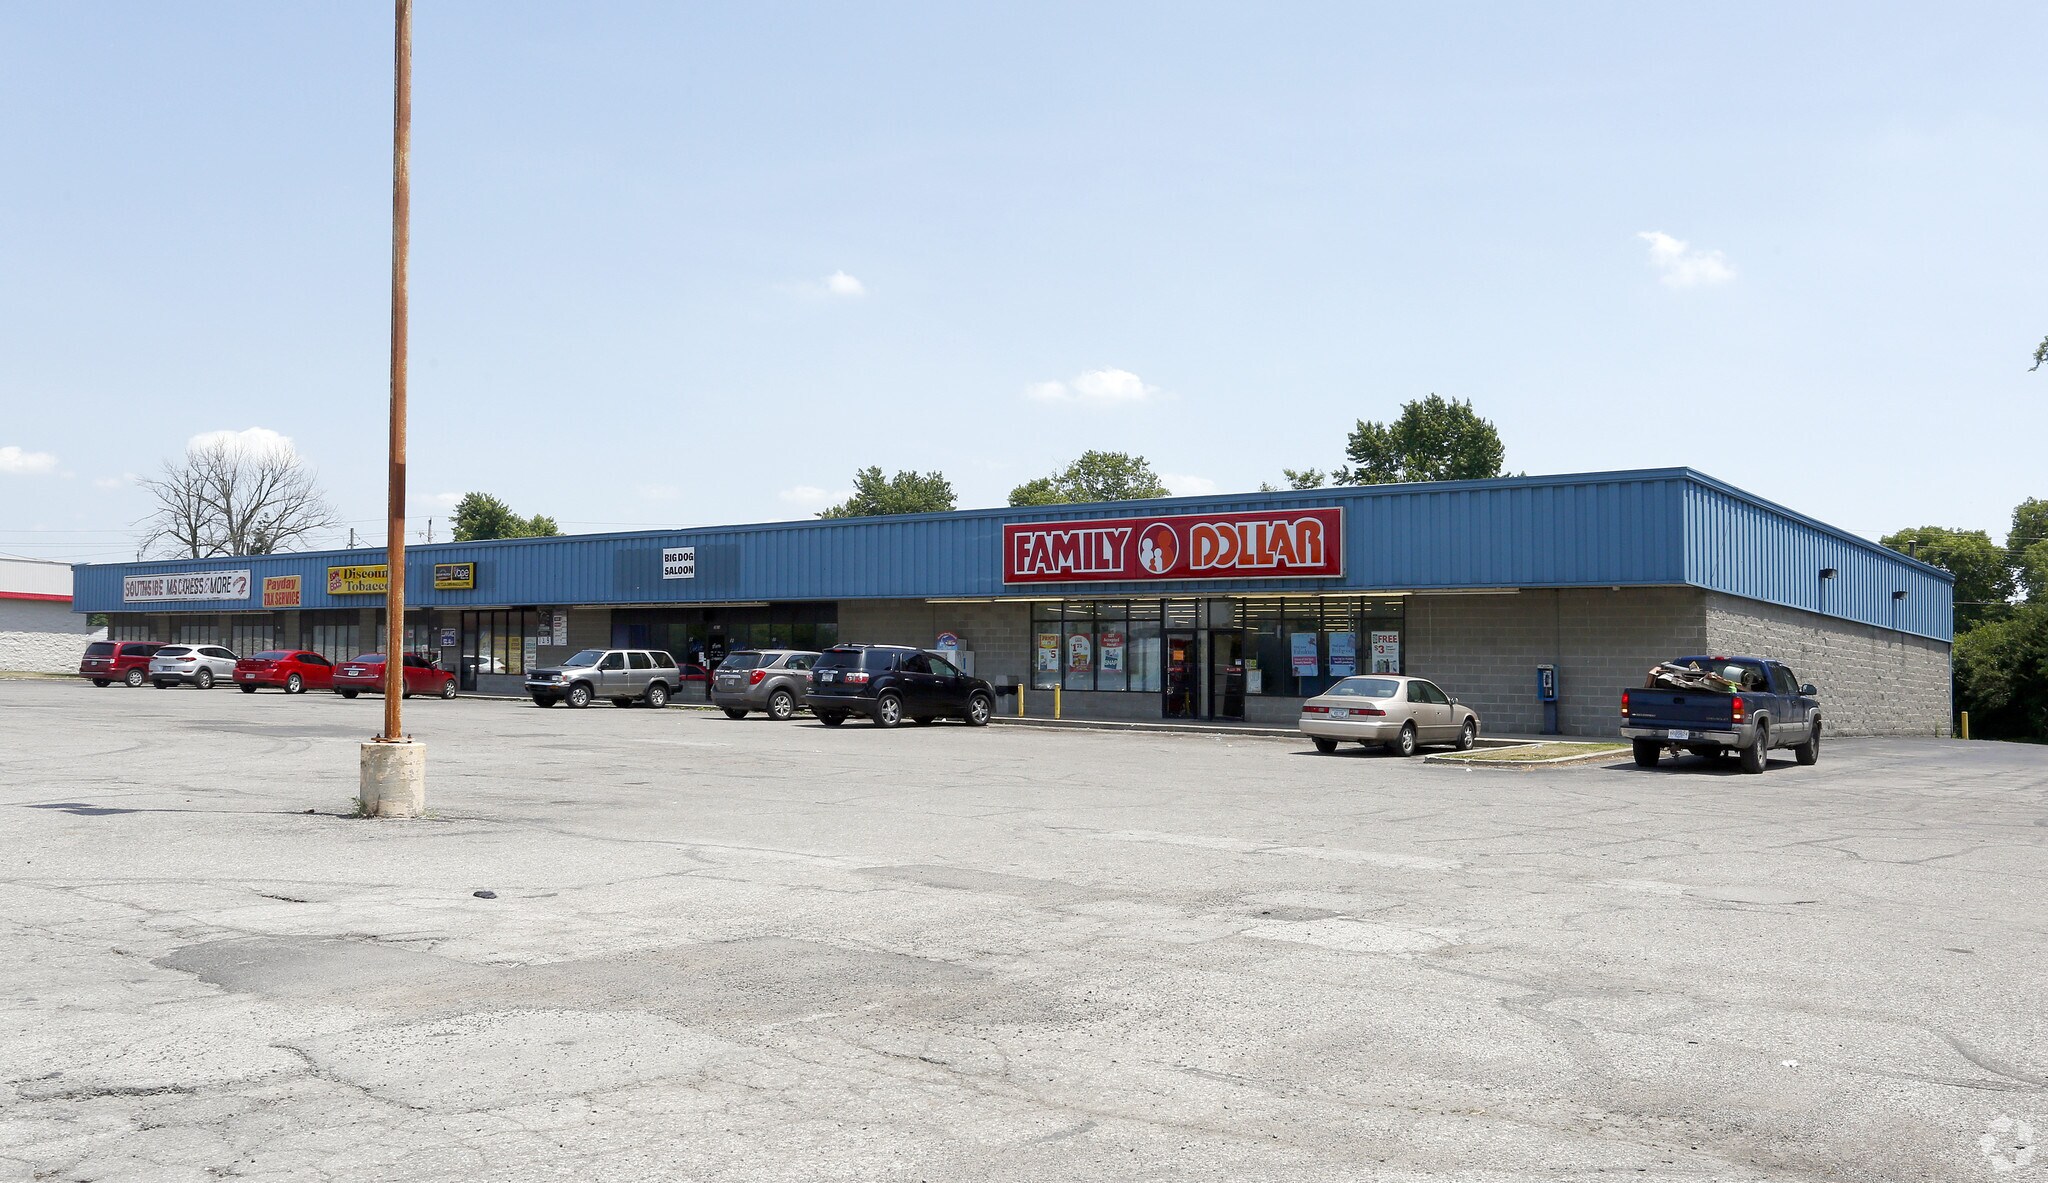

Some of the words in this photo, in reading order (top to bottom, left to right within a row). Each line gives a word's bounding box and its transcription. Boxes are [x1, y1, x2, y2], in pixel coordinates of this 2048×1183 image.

[1014, 528, 1132, 575] FAMILY
[1189, 518, 1325, 570] DOLLAR
[664, 554, 677, 562] BIG
[678, 552, 693, 561] DOG
[343, 568, 388, 579] Discoun
[664, 565, 693, 575] SALOON
[210, 576, 231, 593] MORE
[266, 578, 296, 590] Payday
[264, 593, 275, 606] TAX
[275, 591, 300, 605] SERVICE
[1378, 634, 1398, 643] FREE
[1374, 645, 1385, 654] $3
